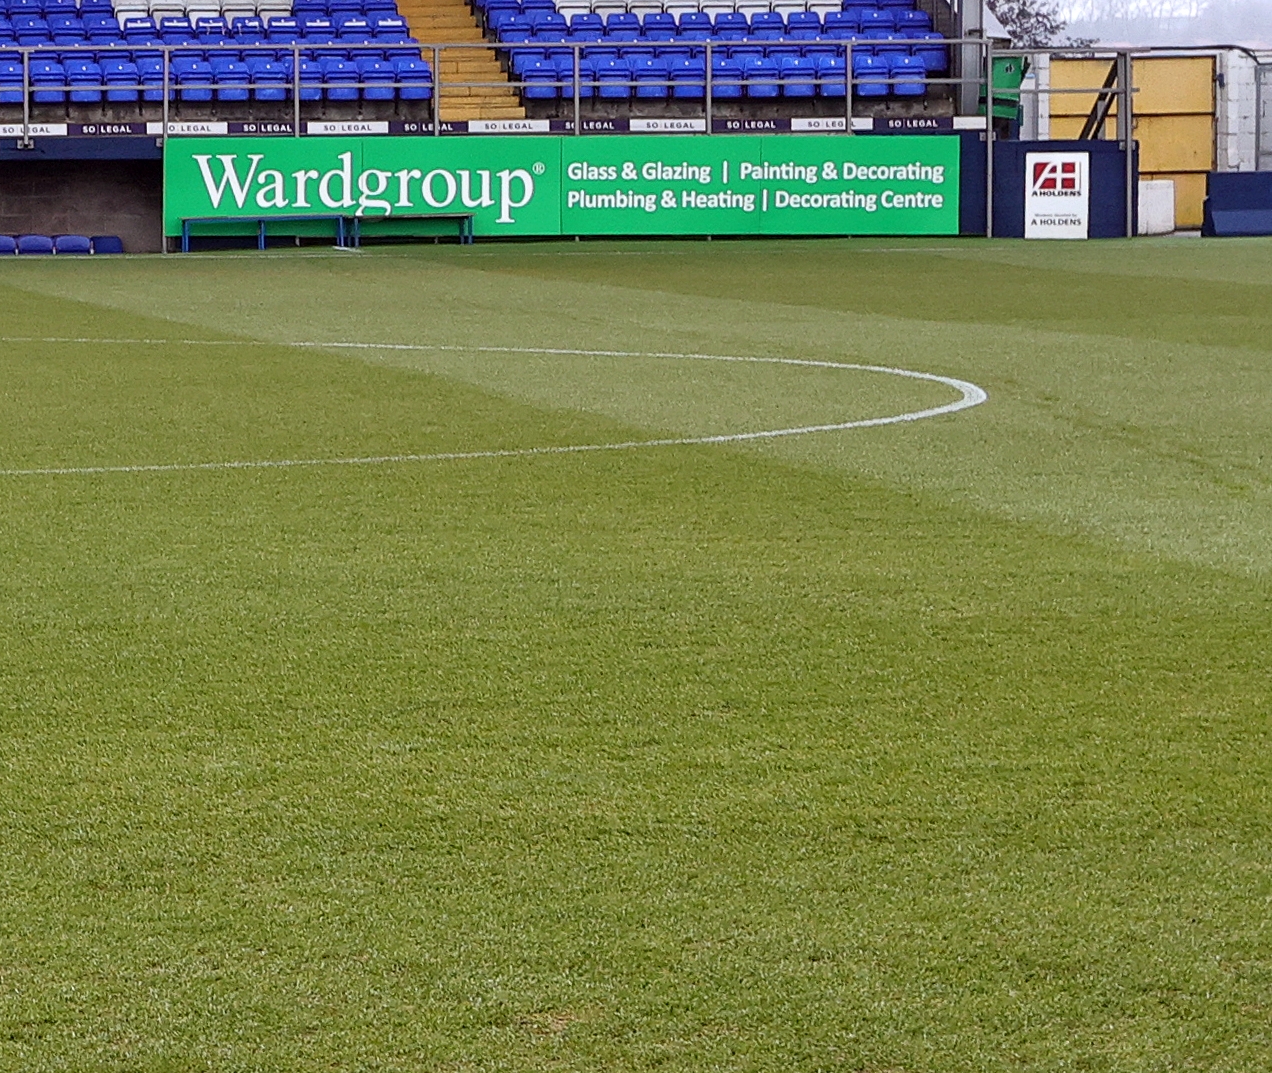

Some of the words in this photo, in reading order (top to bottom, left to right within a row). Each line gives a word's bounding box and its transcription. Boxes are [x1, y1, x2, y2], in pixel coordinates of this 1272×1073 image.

[83, 125, 95, 133] SO
[101, 125, 132, 133] LEGAL
[243, 124, 256, 132] SO
[261, 124, 292, 132] LEGAL
[727, 121, 739, 129] SO
[745, 121, 776, 129] LEGAL
[567, 162, 618, 181] Glass
[621, 162, 638, 181] &
[641, 162, 711, 183] Glazing
[740, 161, 818, 183] Painting
[822, 162, 838, 181] &
[842, 161, 944, 183] Decorating
[567, 190, 656, 212] Plumbing
[660, 191, 677, 209] &
[681, 190, 755, 211] Heating
[775, 190, 877, 211] Decorating
[880, 190, 944, 208] Centre
[1040, 218, 1082, 226] HOLDENS
